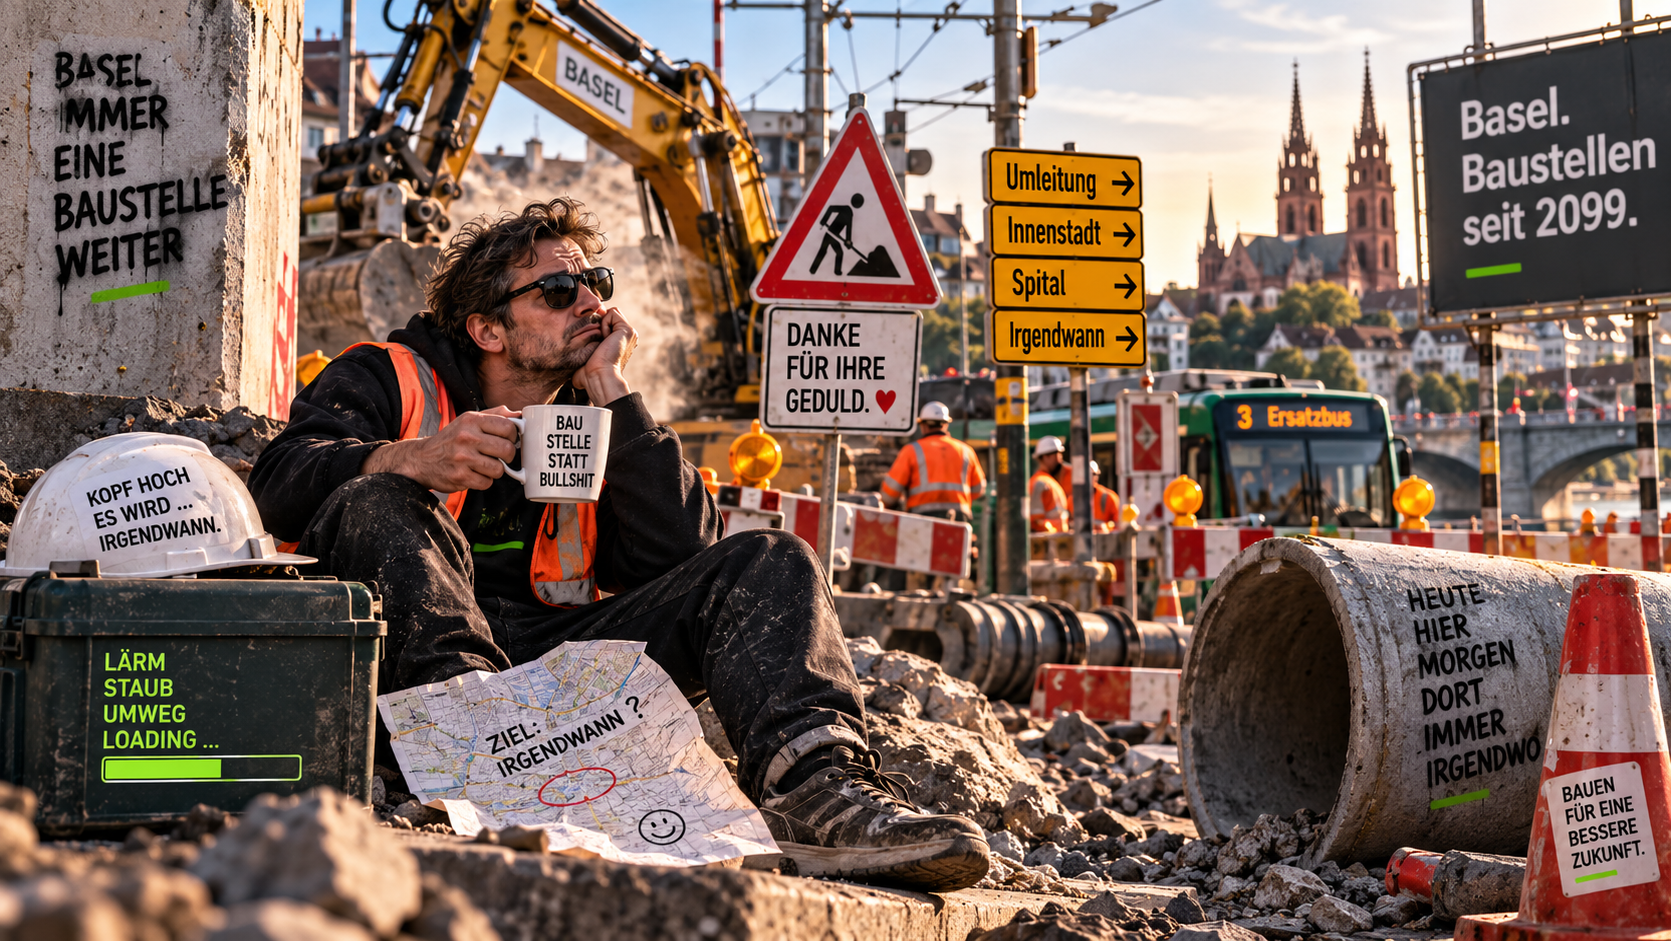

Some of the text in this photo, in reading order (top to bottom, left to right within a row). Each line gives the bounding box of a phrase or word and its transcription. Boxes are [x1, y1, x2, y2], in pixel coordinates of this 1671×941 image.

[55, 52, 152, 88] BASEL
[565, 56, 626, 114] BASEL
[1461, 86, 1570, 140] Basel.
[54, 141, 126, 181] EINE
[1462, 133, 1656, 193] Baustellen
[1006, 162, 1097, 200] Umleitung
[54, 175, 228, 232] BAUSTELLE
[1463, 188, 1638, 246] seit 2099.
[1008, 216, 1101, 246] Innenstadt
[55, 228, 183, 280] WEITER
[1012, 269, 1066, 301] Spital
[787, 323, 861, 347] DANKE
[1009, 321, 1105, 355] Irgendwann
[786, 351, 885, 380] FÜR IHRE
[786, 389, 870, 413] GEDULD.
[1237, 405, 1352, 429] 3 Ersatzbus
[556, 415, 583, 430] BAU
[547, 434, 591, 450] STELLE
[548, 453, 588, 469] STATT
[86, 467, 190, 507] KOPF HOCH
[540, 472, 595, 488] BULLSHIT
[93, 510, 117, 529] ES
[120, 496, 171, 523] WIRD
[99, 516, 221, 552] IRGENDWANN.
[1407, 583, 1486, 612] HEUTE
[1413, 614, 1471, 645] HIER
[104, 648, 165, 671] LÄRM
[1417, 639, 1516, 679] MORGEN
[104, 678, 173, 697] STAUB
[1421, 677, 1484, 716] DORT
[103, 704, 186, 723] UMWEG
[1424, 708, 1507, 751] IMMER
[103, 730, 197, 749] LOADING
[486, 721, 542, 756] ZIEL:
[497, 696, 643, 778] IRGENDWANN ?
[1427, 736, 1541, 788] IRGENDWO
[1561, 776, 1615, 803] BAUEN
[1565, 796, 1634, 825] FÜR EINE
[1568, 818, 1638, 847] BESSERE
[1572, 840, 1645, 869] ZUKUNFT.
